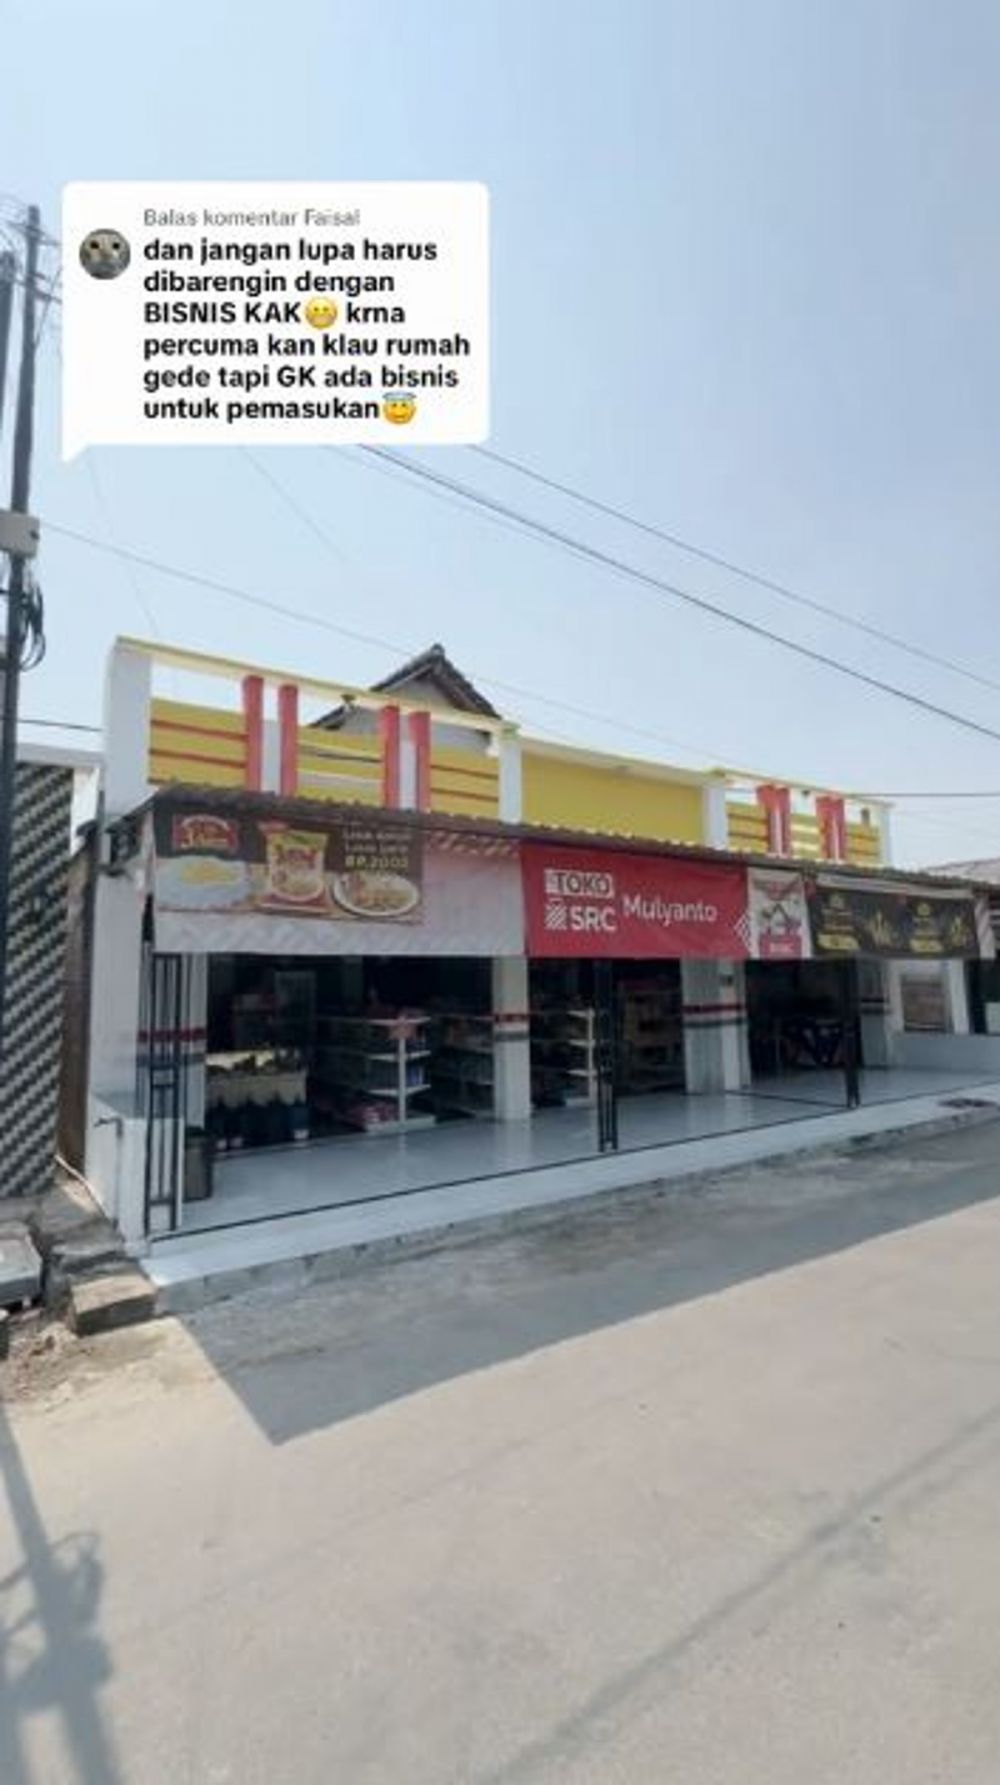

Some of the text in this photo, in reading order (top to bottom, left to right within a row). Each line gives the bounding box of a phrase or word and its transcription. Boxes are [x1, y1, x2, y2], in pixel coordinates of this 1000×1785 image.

[554, 872, 611, 894] TOKO
[570, 906, 617, 932] SRC
[622, 894, 718, 927] Mulyanto
